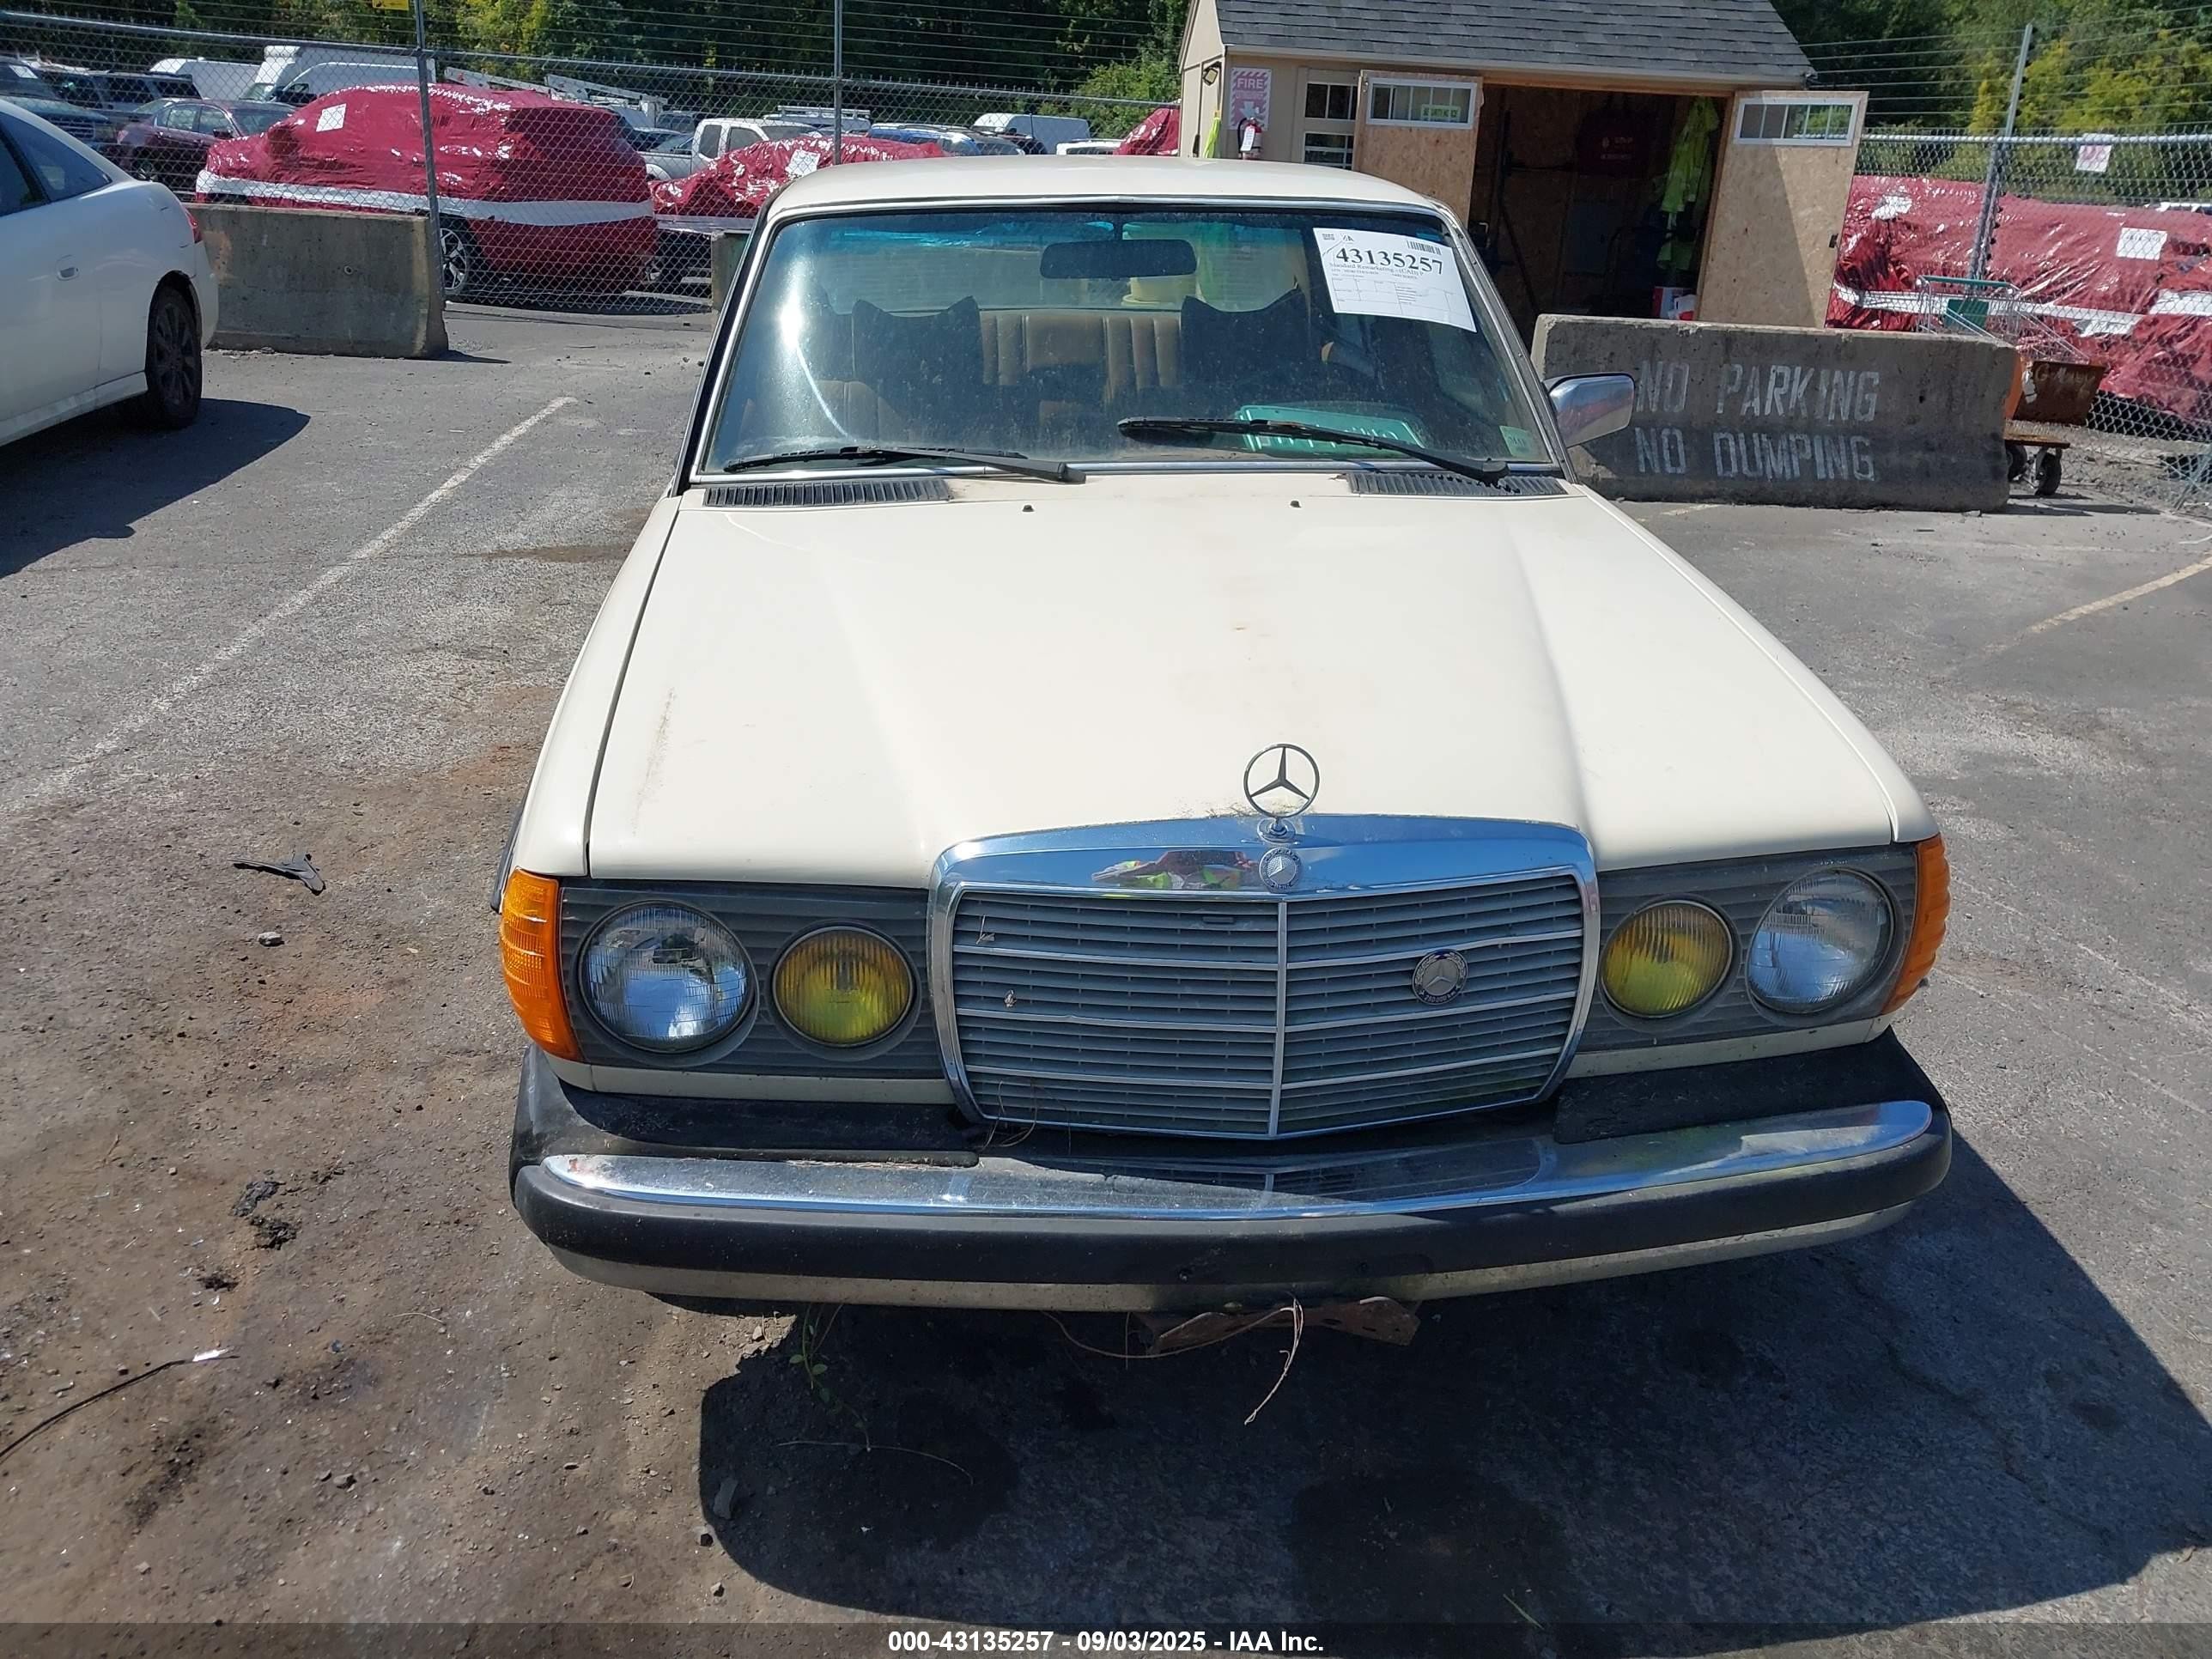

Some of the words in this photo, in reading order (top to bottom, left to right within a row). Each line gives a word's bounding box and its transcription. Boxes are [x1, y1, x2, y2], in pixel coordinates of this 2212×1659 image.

[1237, 77, 1265, 89] FIRE
[1335, 246, 1443, 275] 43135257
[1635, 360, 1689, 413] NO
[1717, 363, 1880, 422] PARKING
[1635, 428, 1686, 474] NO
[1713, 431, 1875, 482] DUMPING
